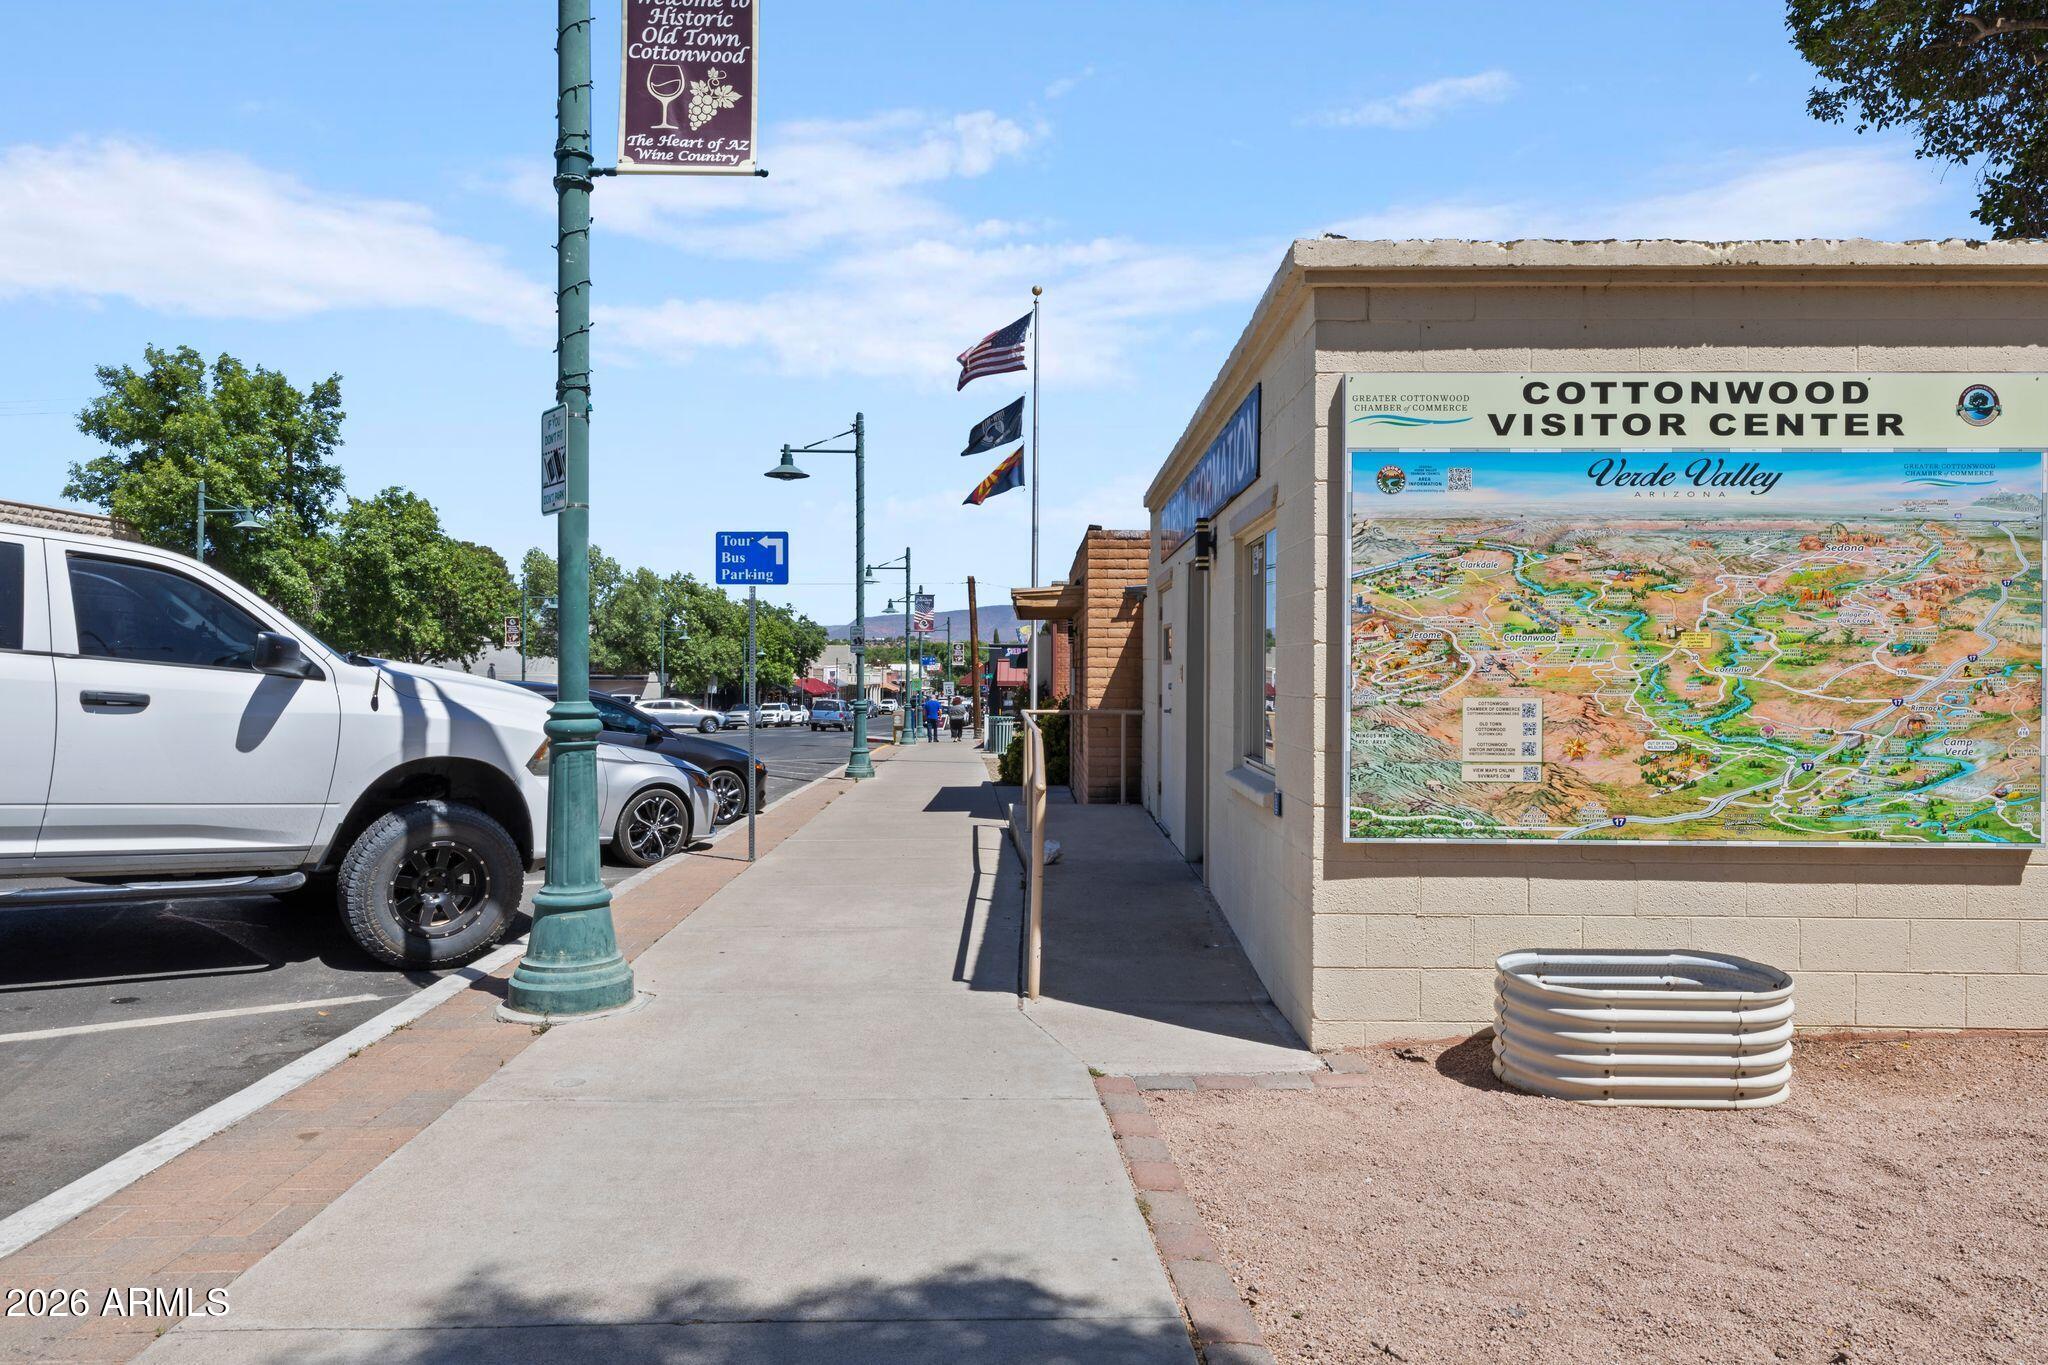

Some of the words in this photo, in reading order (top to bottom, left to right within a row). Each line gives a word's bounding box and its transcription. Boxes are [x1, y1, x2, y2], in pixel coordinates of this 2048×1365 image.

[647, 6, 734, 27] Historic
[642, 26, 682, 44] Old
[683, 27, 741, 47] Town
[628, 43, 750, 64] Cottonwood
[626, 133, 654, 146] The
[657, 134, 704, 149] Heart
[707, 137, 726, 152] of
[725, 139, 750, 151] AZ
[635, 147, 674, 160] Wine
[678, 150, 739, 165] Country
[1522, 381, 1869, 405] COTTONWOOD
[1354, 404, 1402, 412] CHAMBER
[1403, 404, 1411, 413] of
[1412, 404, 1468, 412] COMMERCE
[1487, 413, 1687, 437] VISITOR
[1708, 413, 1904, 437] CENTER
[1587, 457, 1676, 487] Verde
[1684, 457, 1784, 496] Valley
[721, 535, 751, 547] Tour
[1825, 543, 1864, 551] Sedona
[721, 552, 746, 563] Bus
[1460, 560, 1498, 569] Clarkdale
[721, 569, 774, 583] Parking
[1410, 631, 1442, 639] Jerome
[1503, 633, 1557, 642] Cottonwood
[1943, 738, 1973, 747] Camp
[1945, 748, 1974, 756] Verde
